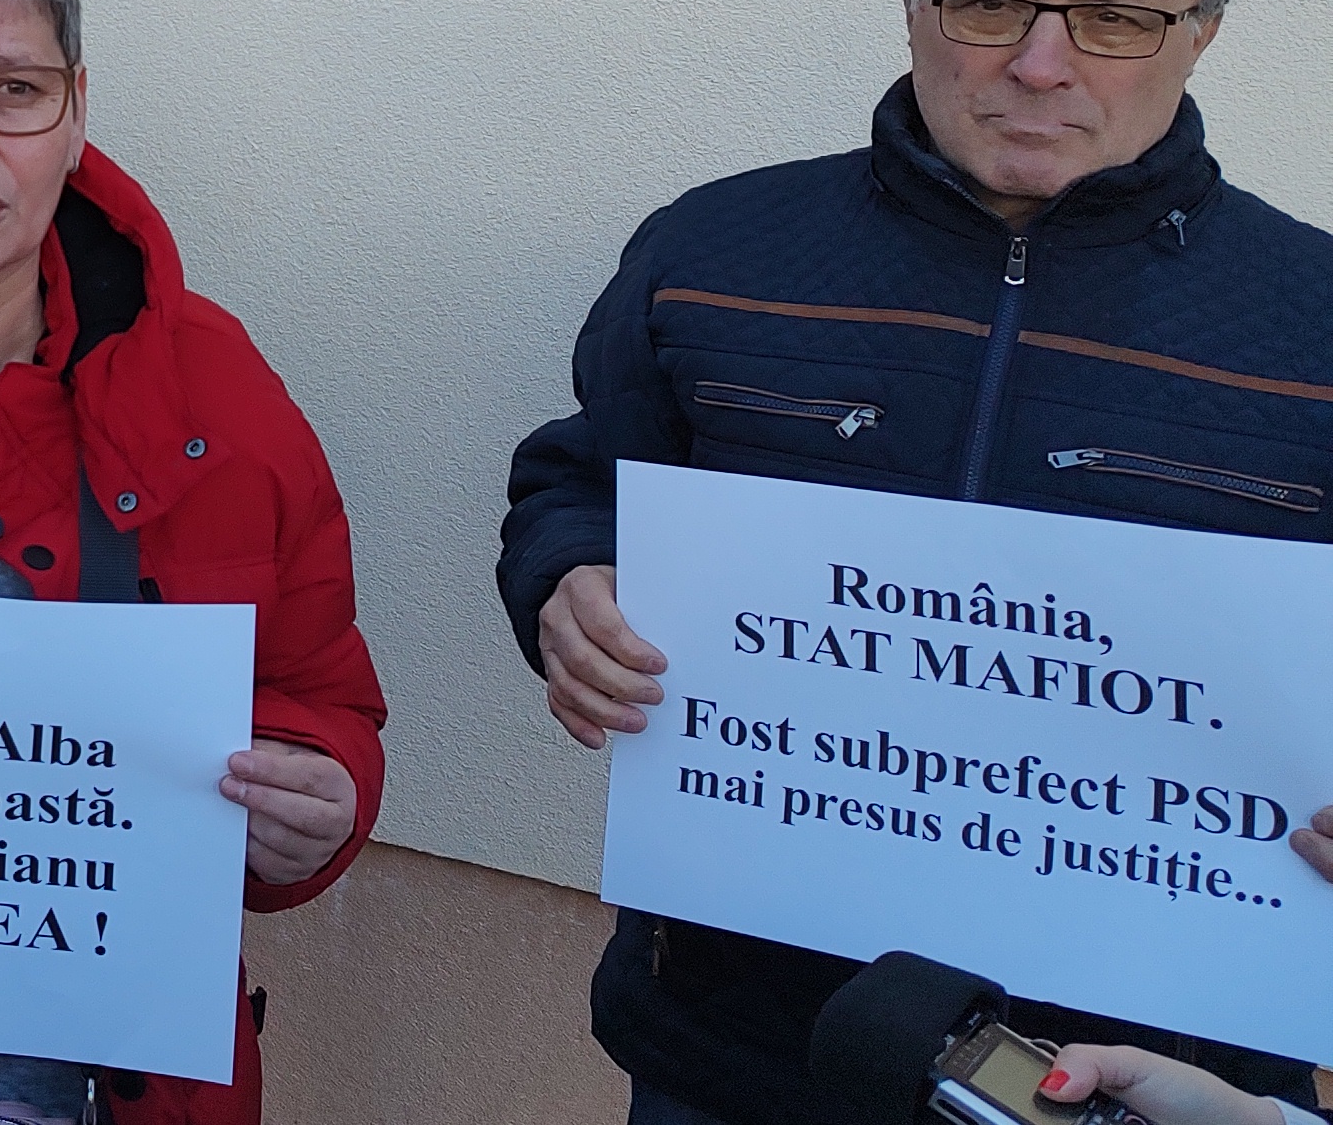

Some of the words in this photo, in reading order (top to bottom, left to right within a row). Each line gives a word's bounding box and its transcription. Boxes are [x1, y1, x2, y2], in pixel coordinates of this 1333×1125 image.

[735, 611, 893, 674] STAT
[910, 637, 1224, 731] MAFIOT.
[827, 562, 1114, 657] România,
[682, 696, 797, 757] Fost
[813, 729, 1127, 816] subprefect
[1147, 777, 1289, 843] PSD
[678, 765, 765, 809] mai
[780, 785, 942, 842] presus
[961, 811, 1022, 857] de
[1035, 823, 1283, 910] justiție...
